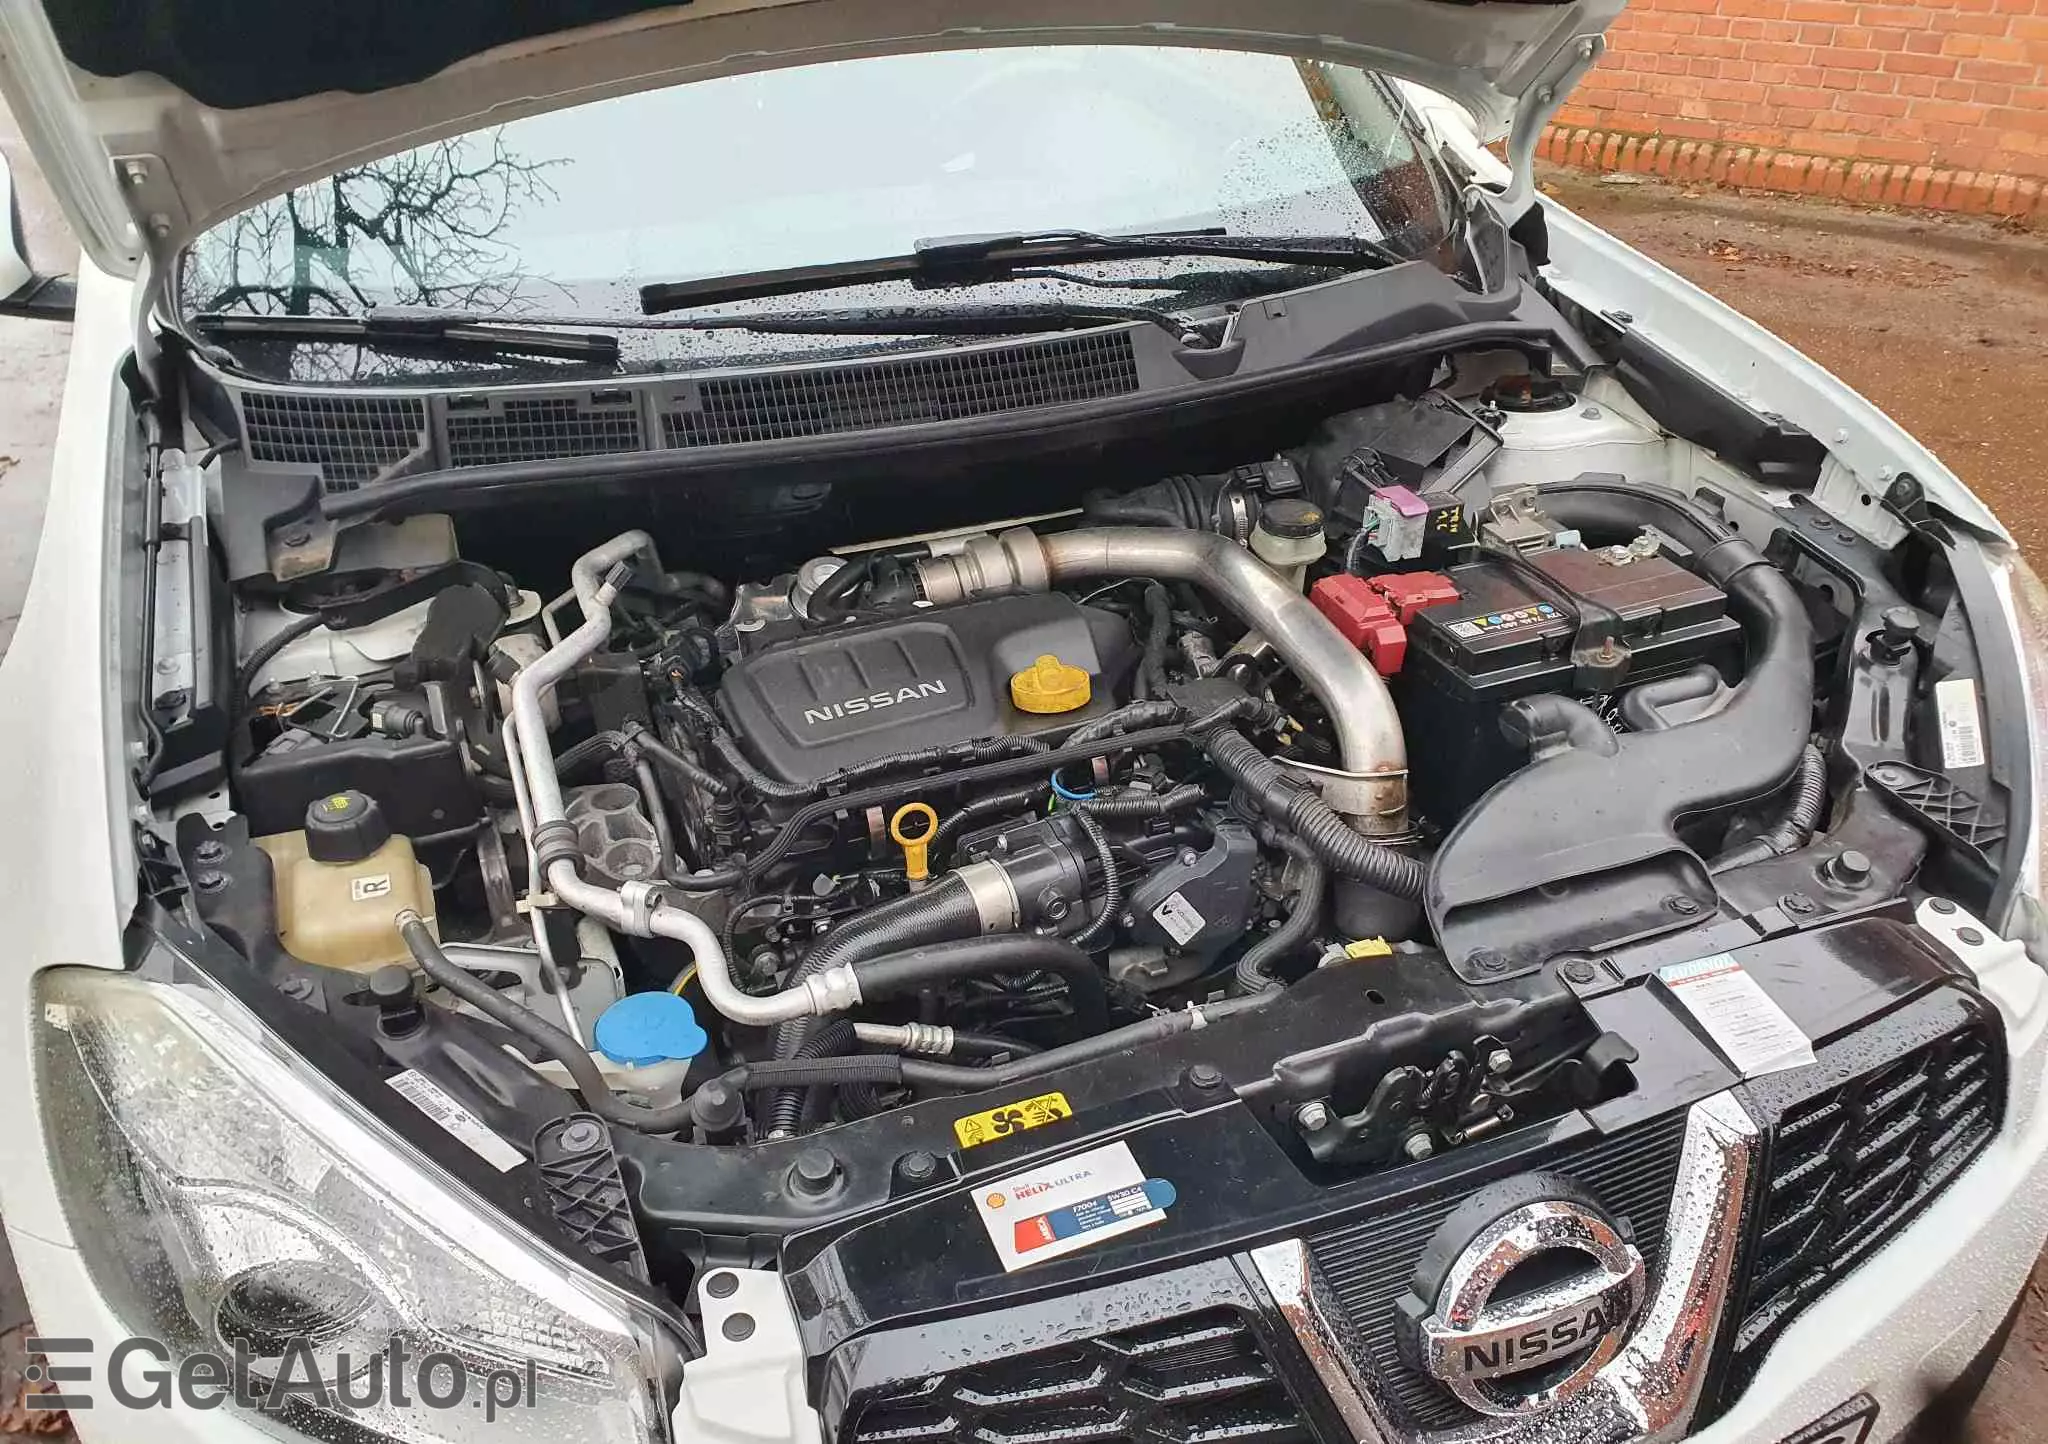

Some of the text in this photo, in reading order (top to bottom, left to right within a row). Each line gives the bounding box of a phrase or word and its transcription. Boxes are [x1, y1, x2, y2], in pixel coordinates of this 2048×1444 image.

[803, 679, 948, 726] NISSAN
[363, 879, 388, 894] R
[1015, 1170, 1094, 1201] HELIX ULTRA
